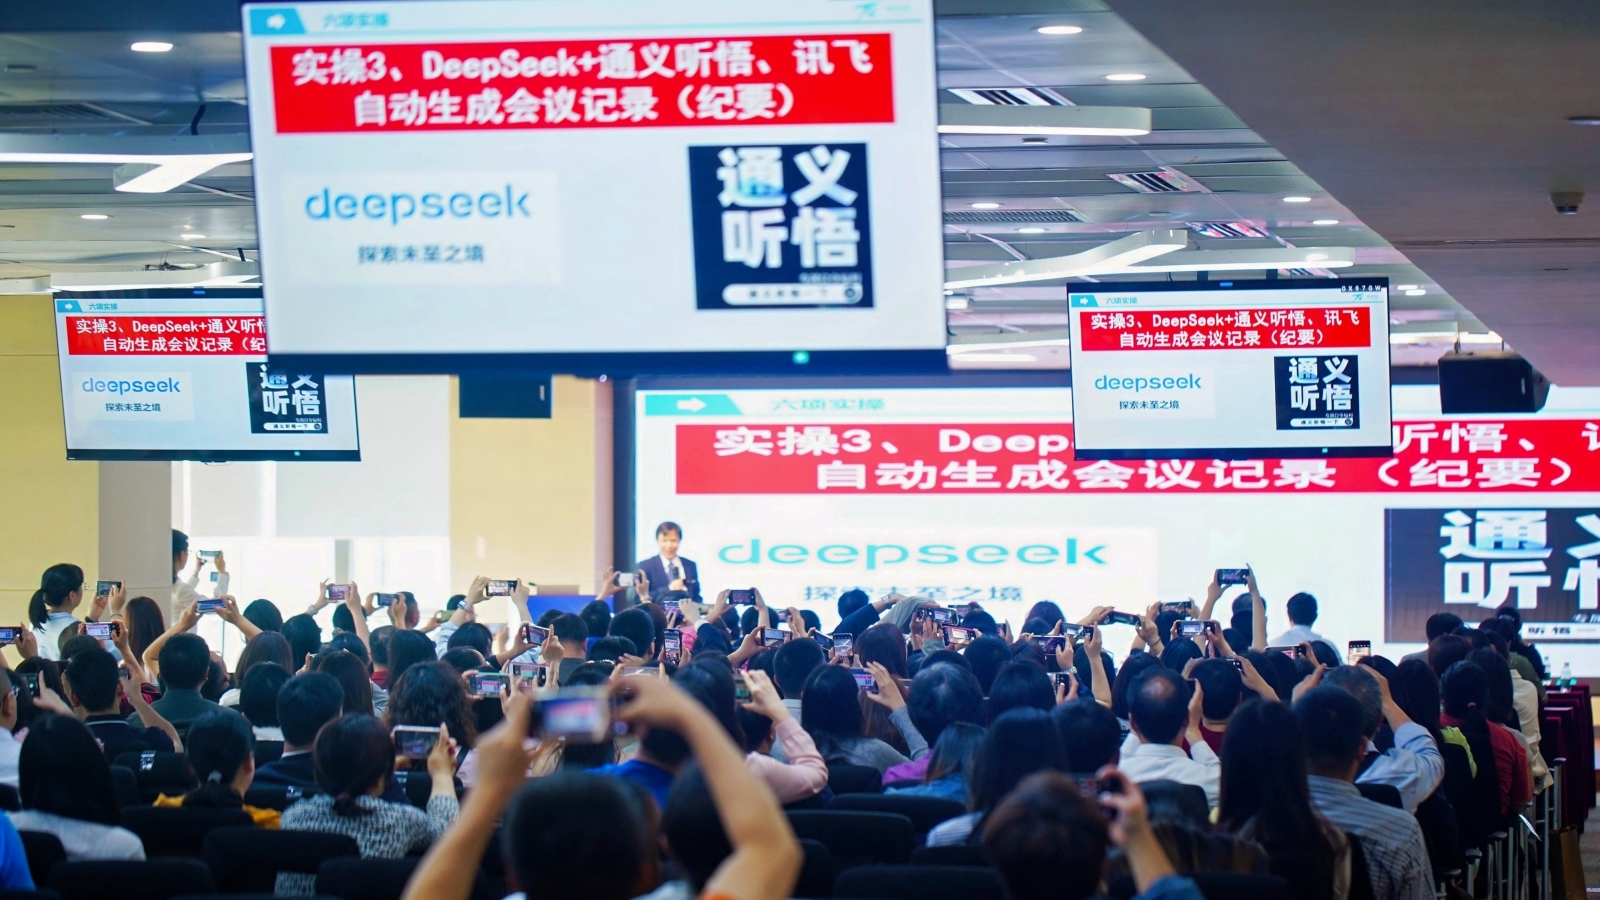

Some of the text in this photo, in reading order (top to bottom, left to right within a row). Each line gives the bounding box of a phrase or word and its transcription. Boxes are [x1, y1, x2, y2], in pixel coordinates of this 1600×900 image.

[292, 40, 874, 86] 实操3、DeepSeek+通义听悟、讯飞
[354, 84, 795, 127] 自动生成会议记录（纪要）
[717, 145, 858, 208] 通义
[305, 184, 533, 226] deepseek
[721, 206, 861, 268] 听悟
[357, 244, 485, 264] 探索未至之境
[1091, 310, 1360, 329] 实操3、DeepSeek+通义听悟、讯飞
[1119, 330, 1325, 348] 自动生成会议记录（纪要）
[1095, 374, 1202, 393] deepseek
[1289, 357, 1352, 384] 通义
[82, 377, 181, 396] deepseek
[1290, 384, 1353, 411] 听悟
[105, 402, 161, 412] 探索未至之境
[262, 390, 320, 415] 听悟
[772, 398, 885, 411] 六项实操
[1119, 400, 1180, 410] 探索未至之境
[713, 426, 1074, 457] 实操3、Deep
[817, 457, 1571, 490] 自动生成会议记录（纪要）
[718, 538, 1108, 570] deepseek
